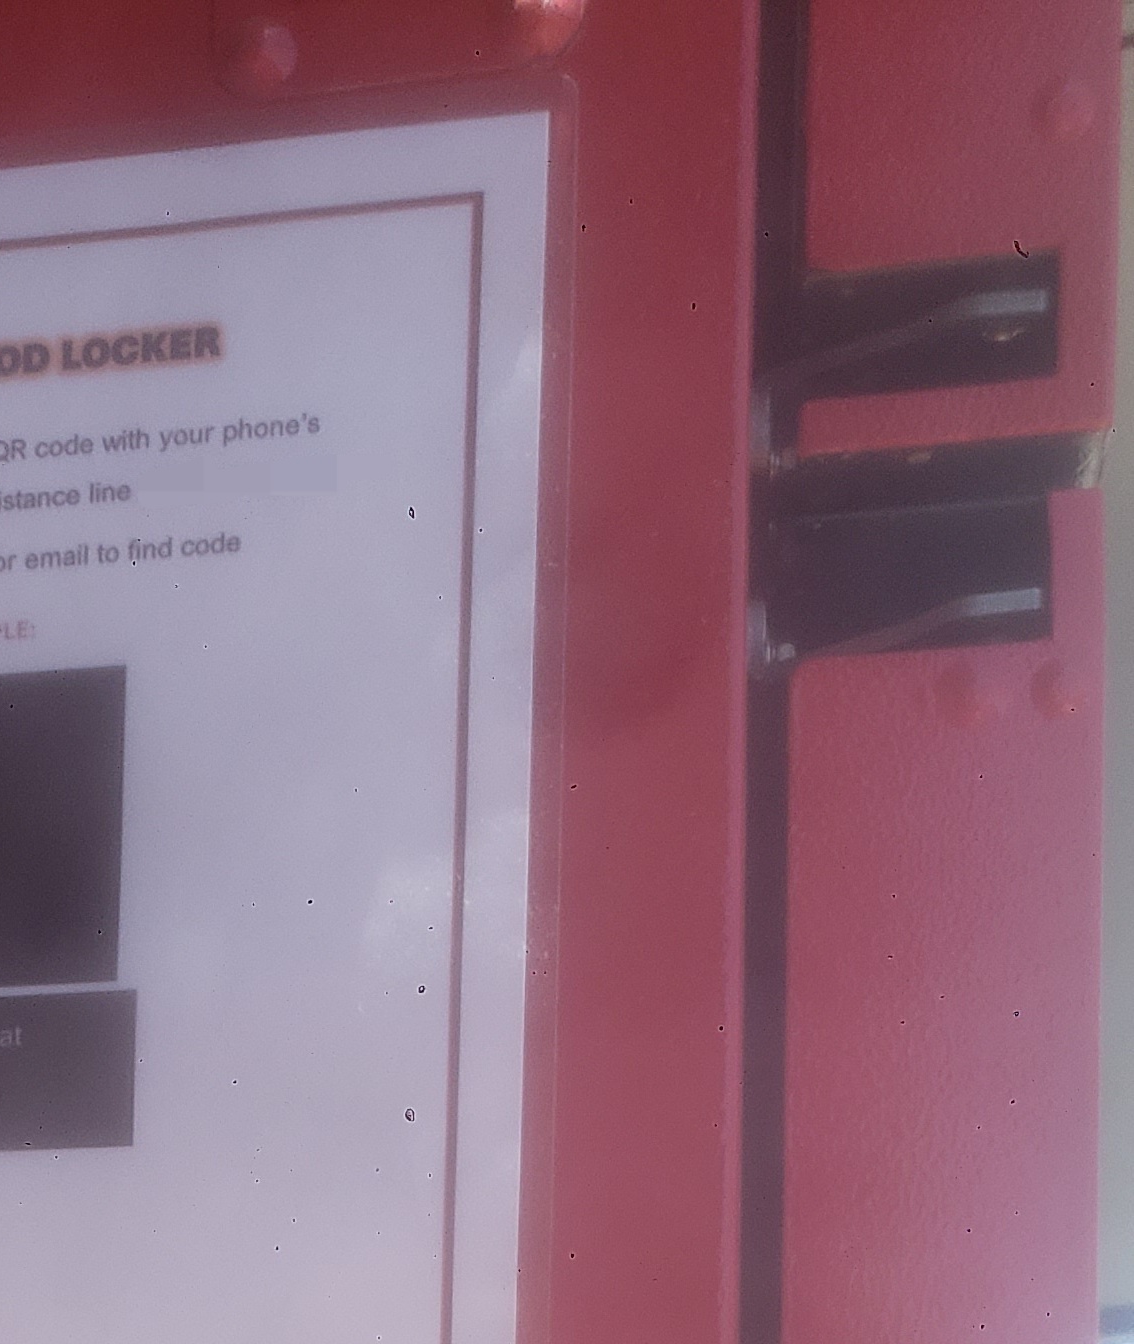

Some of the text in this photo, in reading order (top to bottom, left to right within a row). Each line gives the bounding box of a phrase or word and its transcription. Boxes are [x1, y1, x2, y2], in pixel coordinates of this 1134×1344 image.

[58, 324, 222, 373] LOCKER
[33, 434, 95, 460] code
[101, 428, 151, 453] with
[158, 425, 215, 453] your
[221, 413, 321, 447] phone's
[88, 482, 132, 503] line
[23, 544, 90, 571] email
[96, 544, 121, 565] to
[127, 537, 173, 561] find
[179, 532, 242, 558] code
[0, 1026, 22, 1048] at
